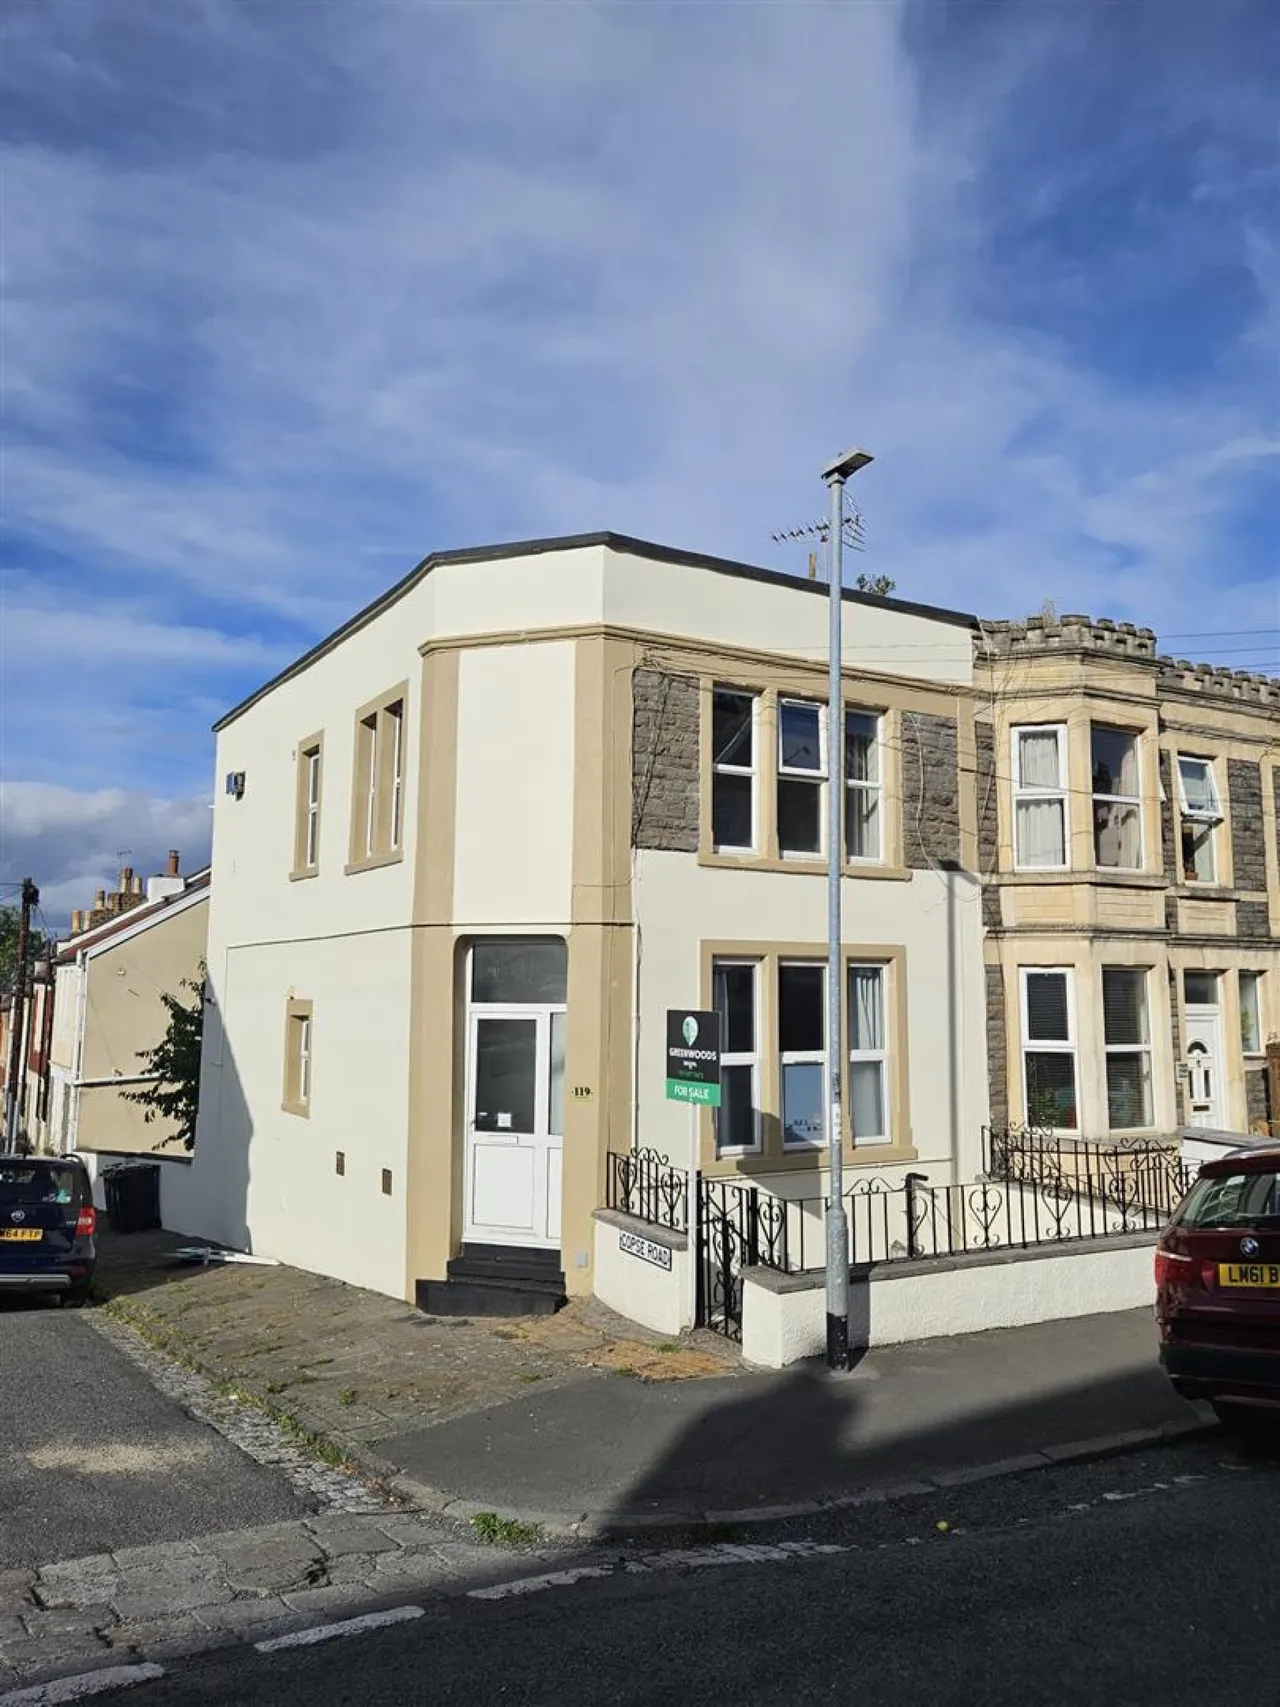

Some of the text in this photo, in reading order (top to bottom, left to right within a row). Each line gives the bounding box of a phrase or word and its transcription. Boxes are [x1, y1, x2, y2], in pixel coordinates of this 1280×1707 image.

[669, 1047, 717, 1061] GREENWOODS
[575, 1086, 591, 1096] 119
[674, 1085, 709, 1099] FOR SALE
[620, 1232, 670, 1266] COPSE ROAD
